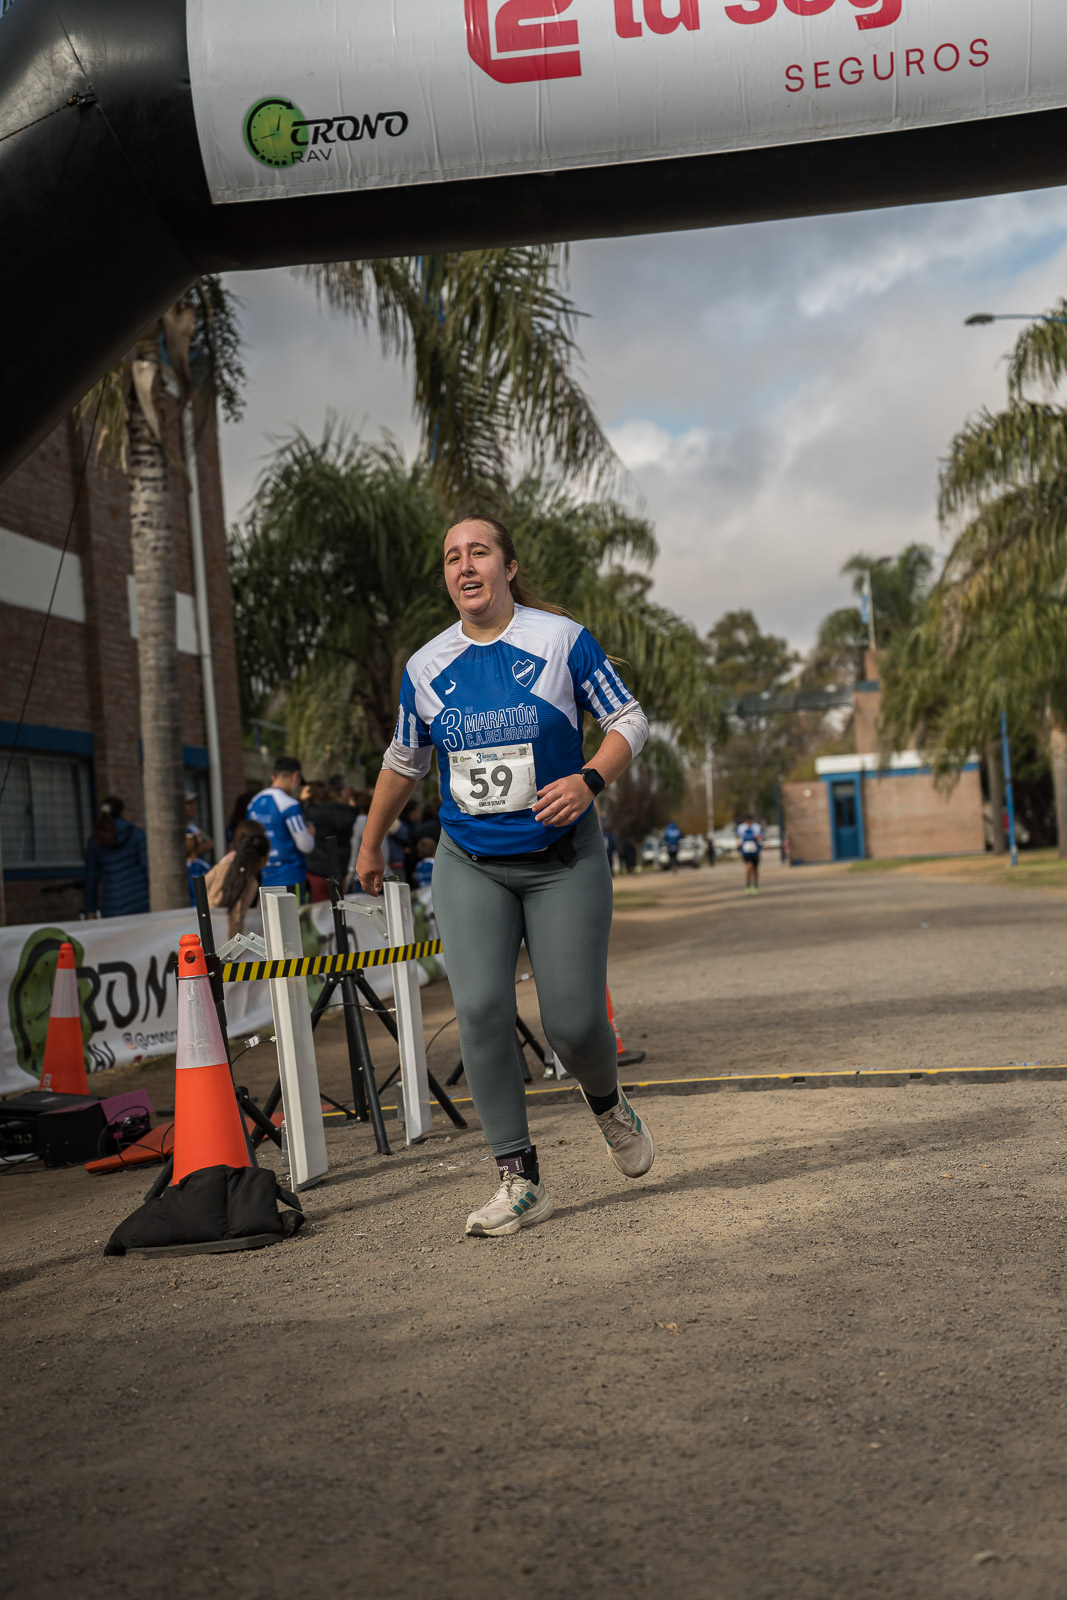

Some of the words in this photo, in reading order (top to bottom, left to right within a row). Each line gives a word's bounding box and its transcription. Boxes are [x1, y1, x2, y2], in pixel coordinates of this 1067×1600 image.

[784, 38, 989, 92] SEGUROS
[290, 111, 408, 146] CRONO
[290, 148, 332, 163] RAV
[440, 707, 465, 752] 3
[464, 703, 539, 733] MARATÓN
[469, 765, 513, 800] 59
[76, 951, 178, 1033] RON
[85, 1041, 116, 1074] AV
